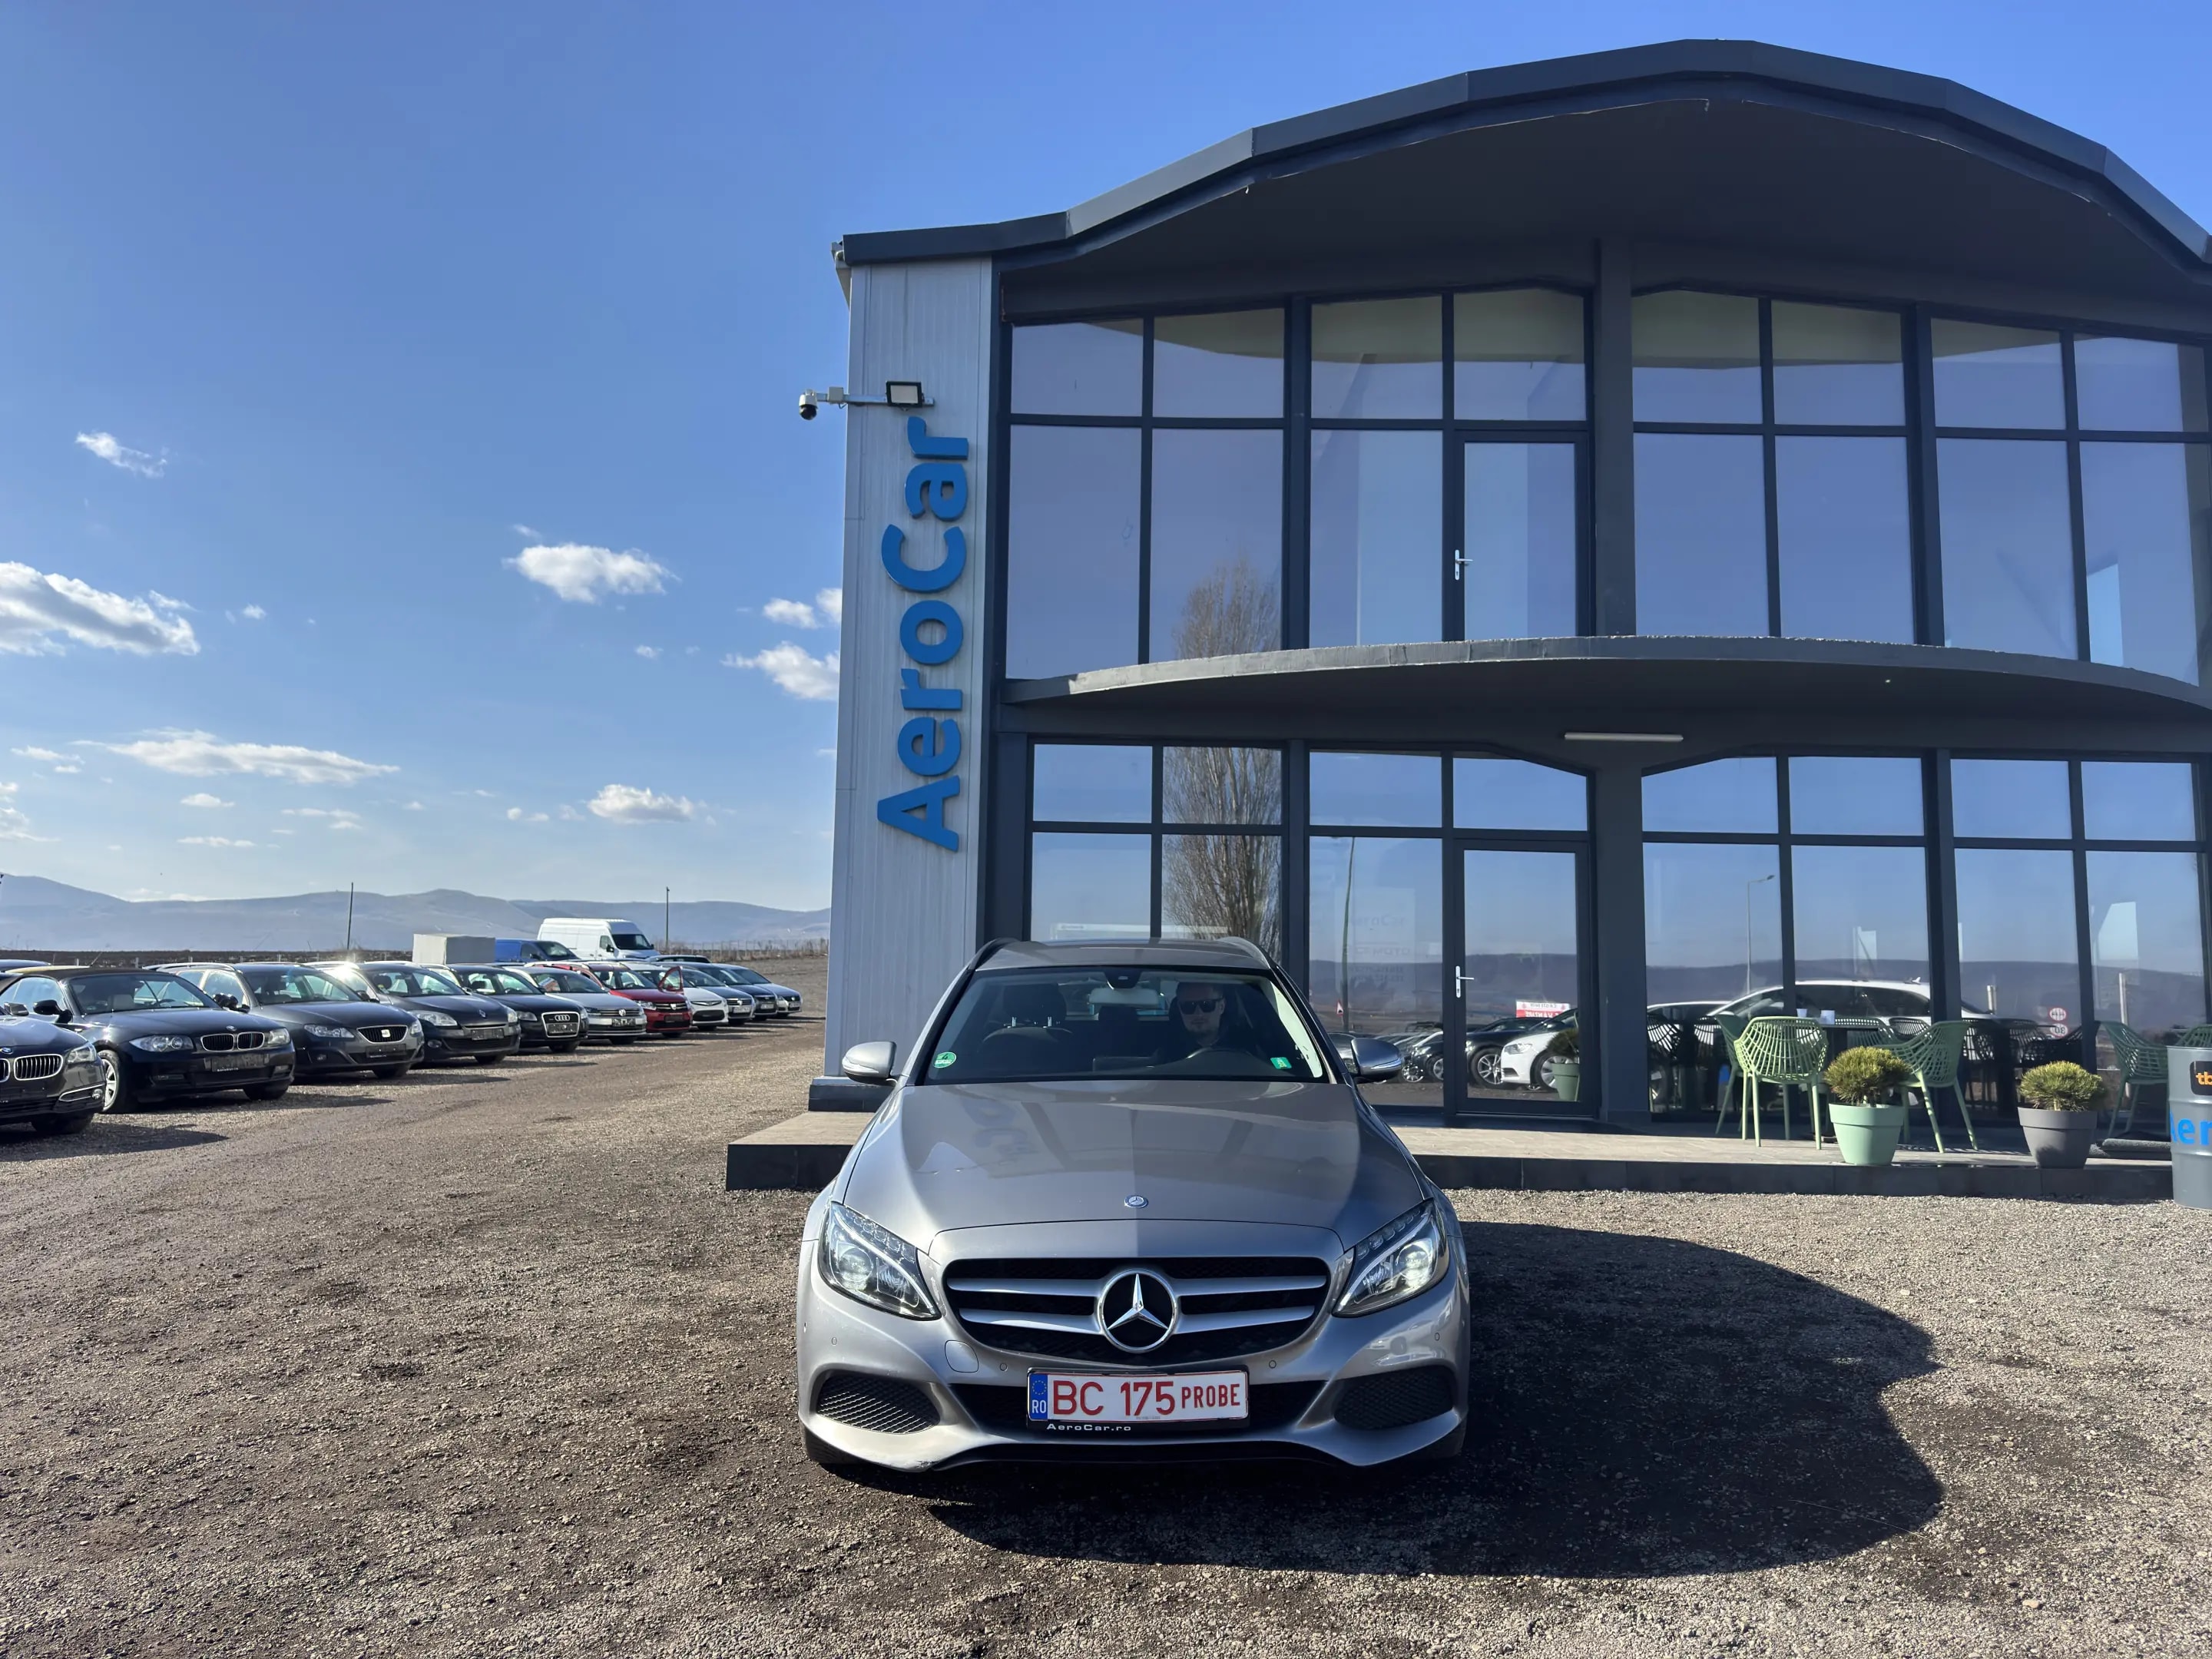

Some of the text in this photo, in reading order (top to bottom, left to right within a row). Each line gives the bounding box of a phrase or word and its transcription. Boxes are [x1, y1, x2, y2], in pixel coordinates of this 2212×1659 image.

[877, 416, 969, 852] AeroCar
[2170, 1109, 2212, 1147] er
[1031, 1399, 1047, 1413] RO
[1053, 1380, 1240, 1416] BC 175 PROBE
[1046, 1423, 1131, 1432] AeroCar.ro
